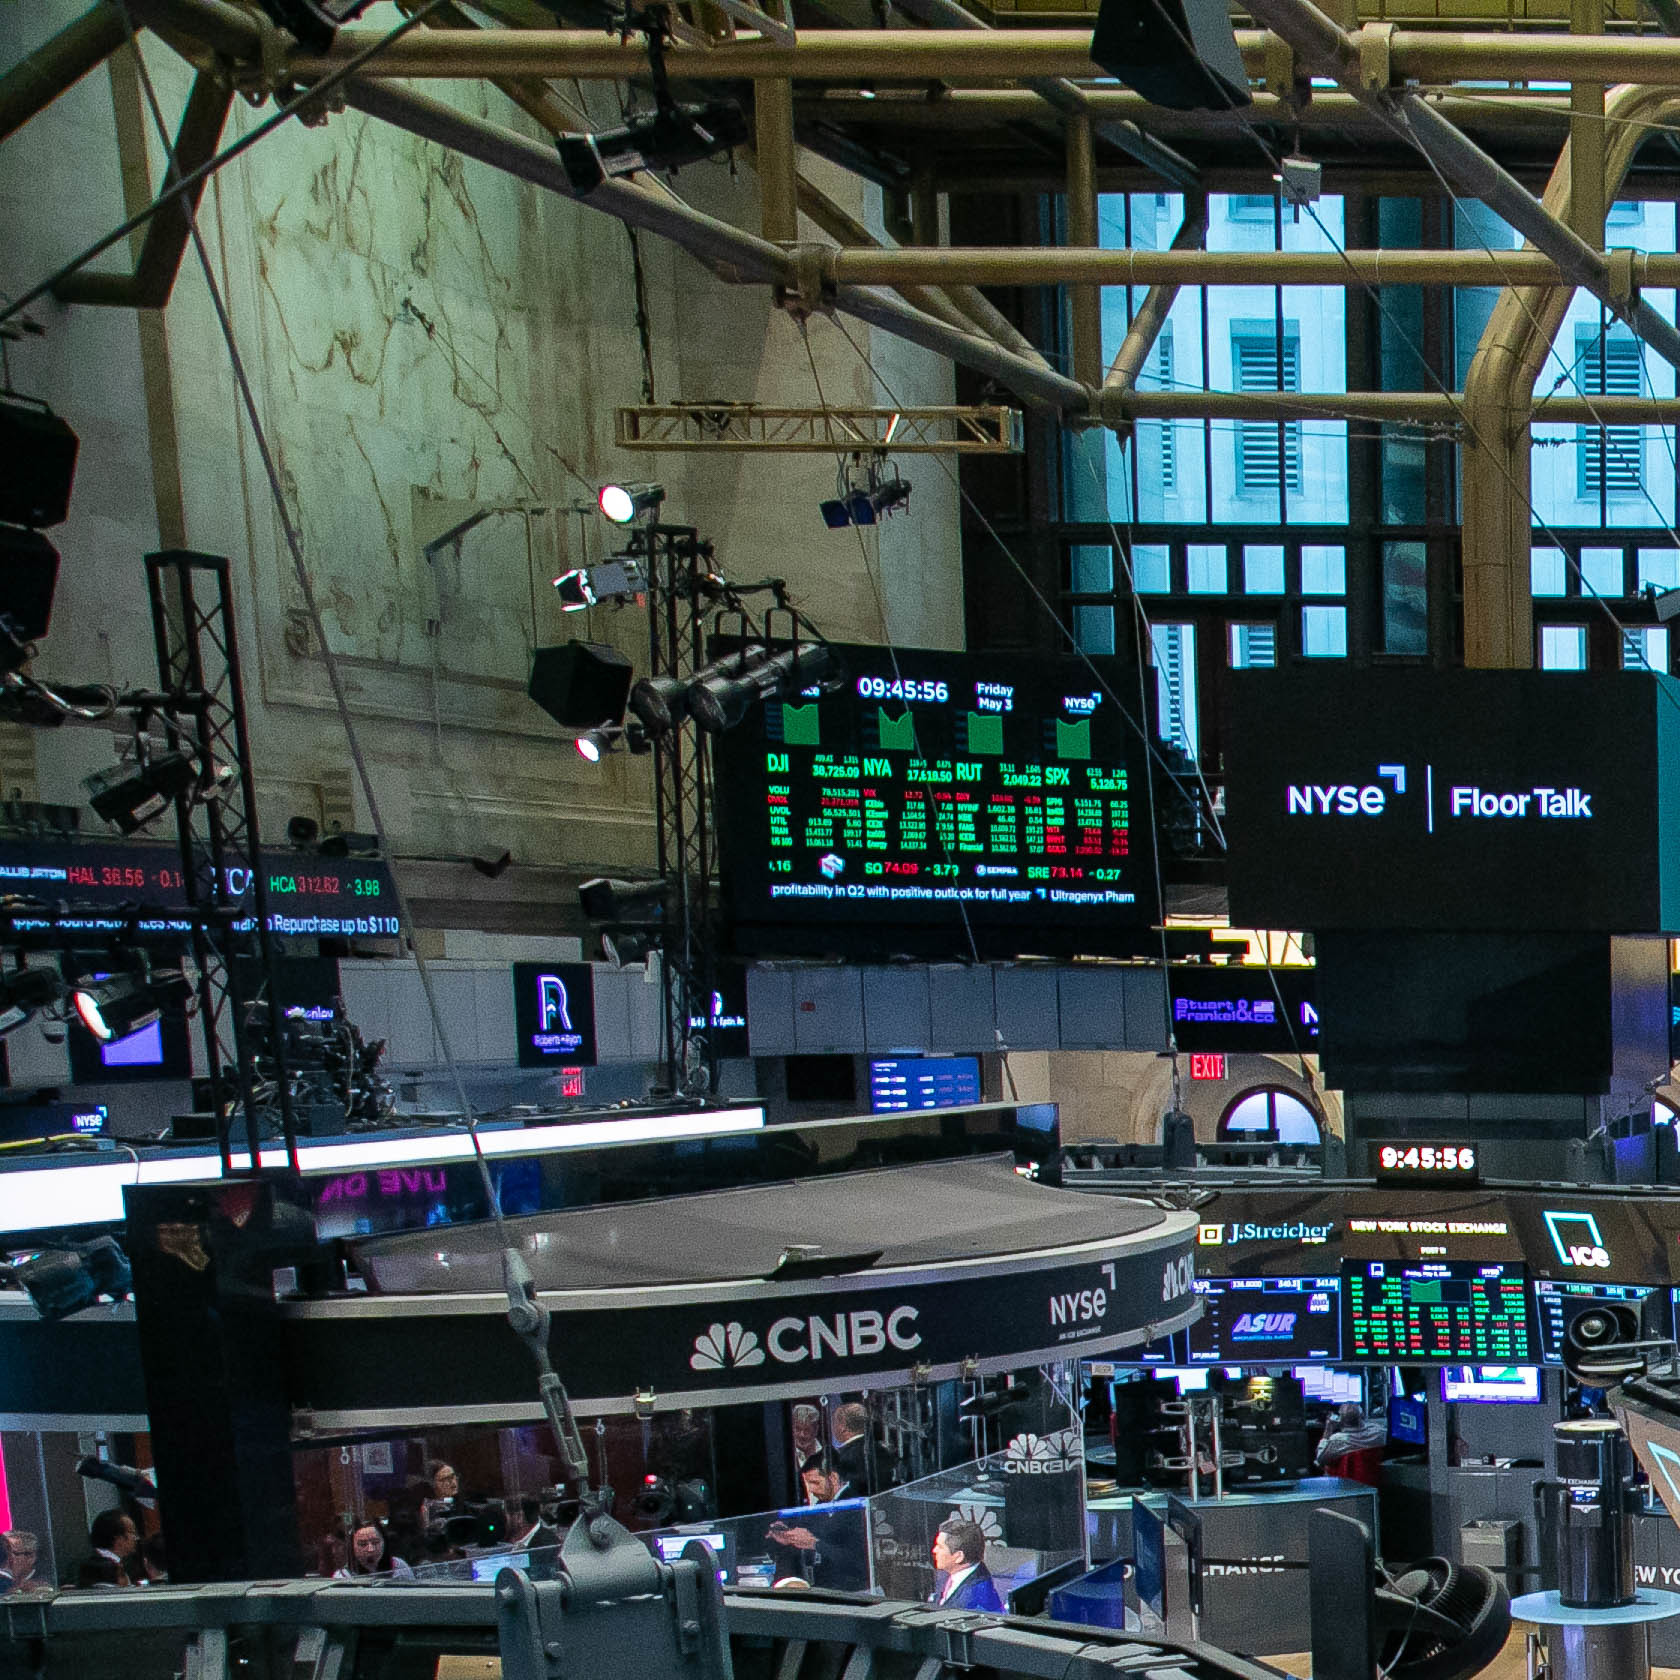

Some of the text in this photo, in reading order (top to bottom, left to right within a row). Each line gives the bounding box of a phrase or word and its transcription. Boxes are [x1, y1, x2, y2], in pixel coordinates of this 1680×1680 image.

[859, 677, 948, 701] 09:45:56
[977, 683, 1013, 696] Friday
[979, 697, 1013, 711] May 3
[768, 754, 789, 772] DJI
[864, 758, 892, 777] NYA
[957, 763, 982, 781] RUT
[1045, 768, 1069, 786] SPX
[69, 868, 97, 885] HAL
[270, 876, 296, 893] HCA
[354, 879, 380, 896] 3.98
[772, 884, 832, 897] profitability
[835, 884, 845, 896] in
[848, 885, 865, 897] Q2
[867, 885, 890, 898] with
[891, 886, 933, 900] positive
[974, 888, 988, 900] for
[990, 888, 1006, 900] full
[1008, 890, 1031, 902] year
[275, 914, 339, 932] Repurchase
[341, 919, 356, 933] up
[357, 917, 367, 932] to
[1193, 1056, 1222, 1078] EXIT
[1380, 1146, 1475, 1170] 9:45:56
[1351, 1221, 1508, 1234] NEW YORK STOCK EXCHANGE
[767, 1304, 922, 1365] CNBC
